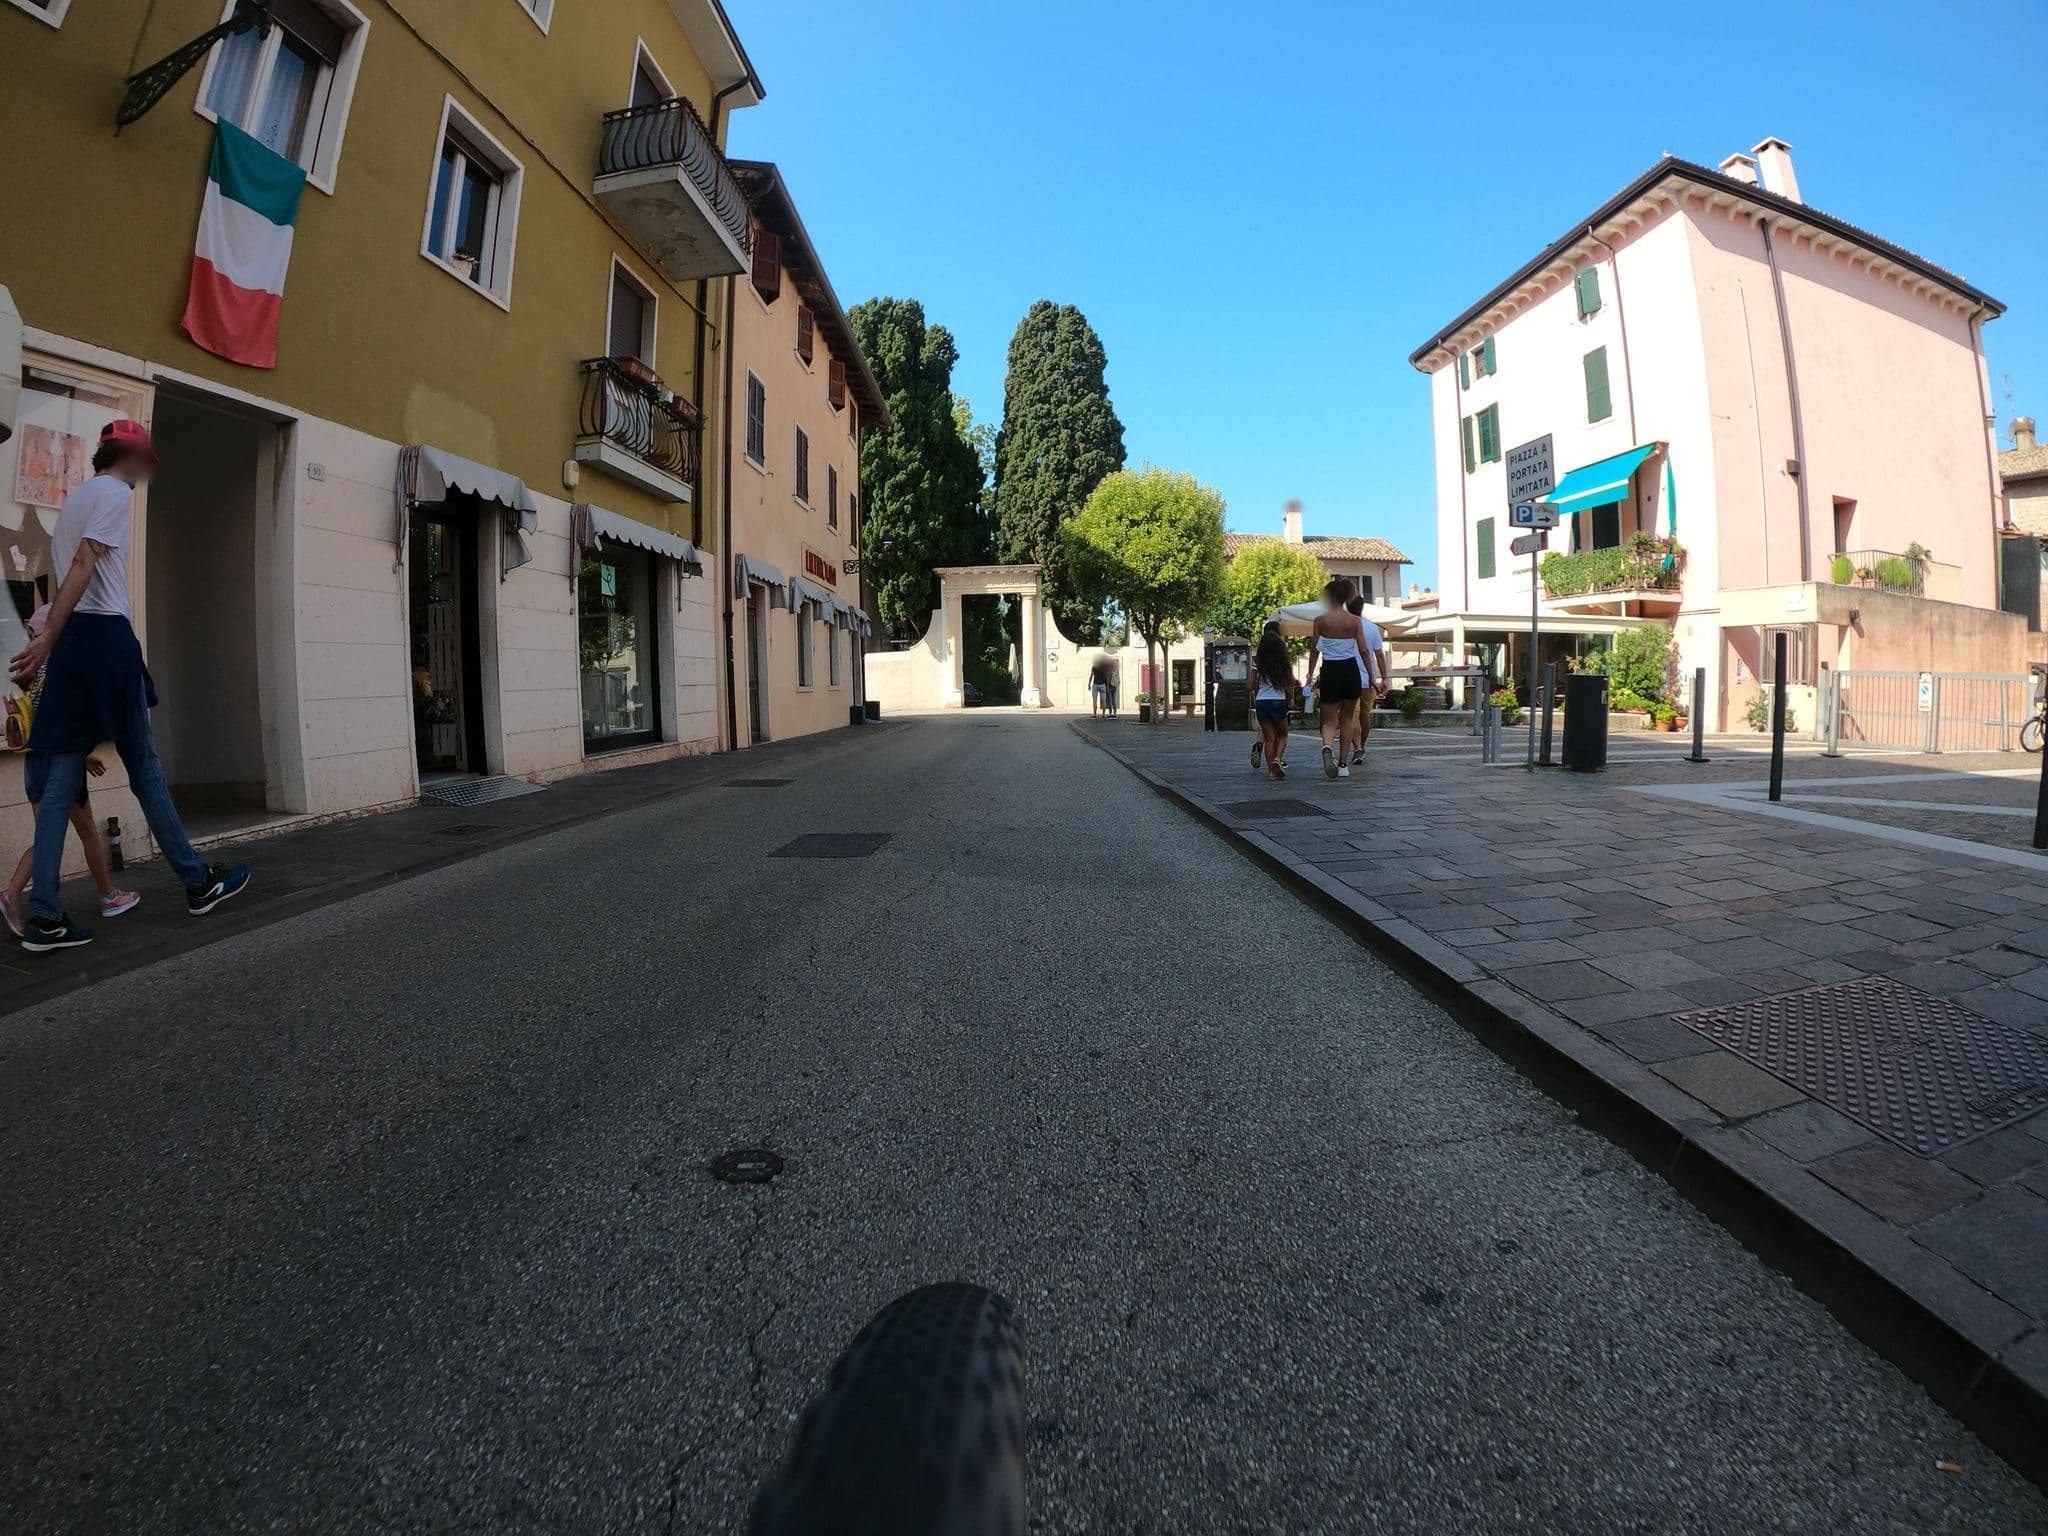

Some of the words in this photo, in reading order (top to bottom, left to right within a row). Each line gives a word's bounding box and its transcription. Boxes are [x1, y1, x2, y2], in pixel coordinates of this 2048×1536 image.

[1510, 447, 1538, 466] PIAZZA
[1541, 443, 1547, 454] A
[1511, 460, 1548, 482] PORTATA
[1511, 477, 1550, 498] LIMITATA
[1518, 507, 1530, 522] P
